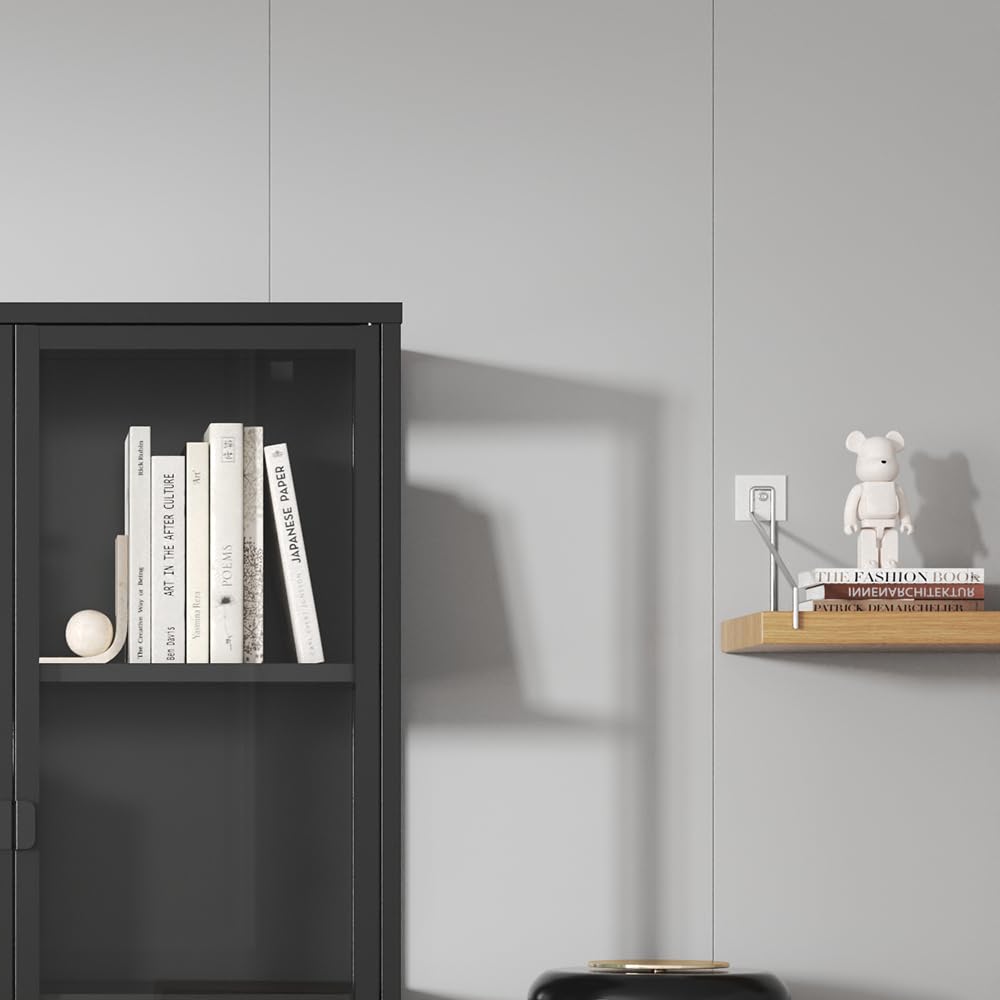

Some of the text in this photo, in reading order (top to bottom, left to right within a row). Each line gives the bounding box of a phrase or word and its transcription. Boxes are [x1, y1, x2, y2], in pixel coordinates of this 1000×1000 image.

[275, 465, 302, 563] JAPANESE PAPER
[163, 473, 175, 597] ART IN THE AFTER CULTURE
[221, 544, 233, 587] POEMS
[816, 571, 981, 583] THE FASHION BOOK
[813, 603, 864, 612] PATRICK
[166, 626, 176, 661] Ben Davis
